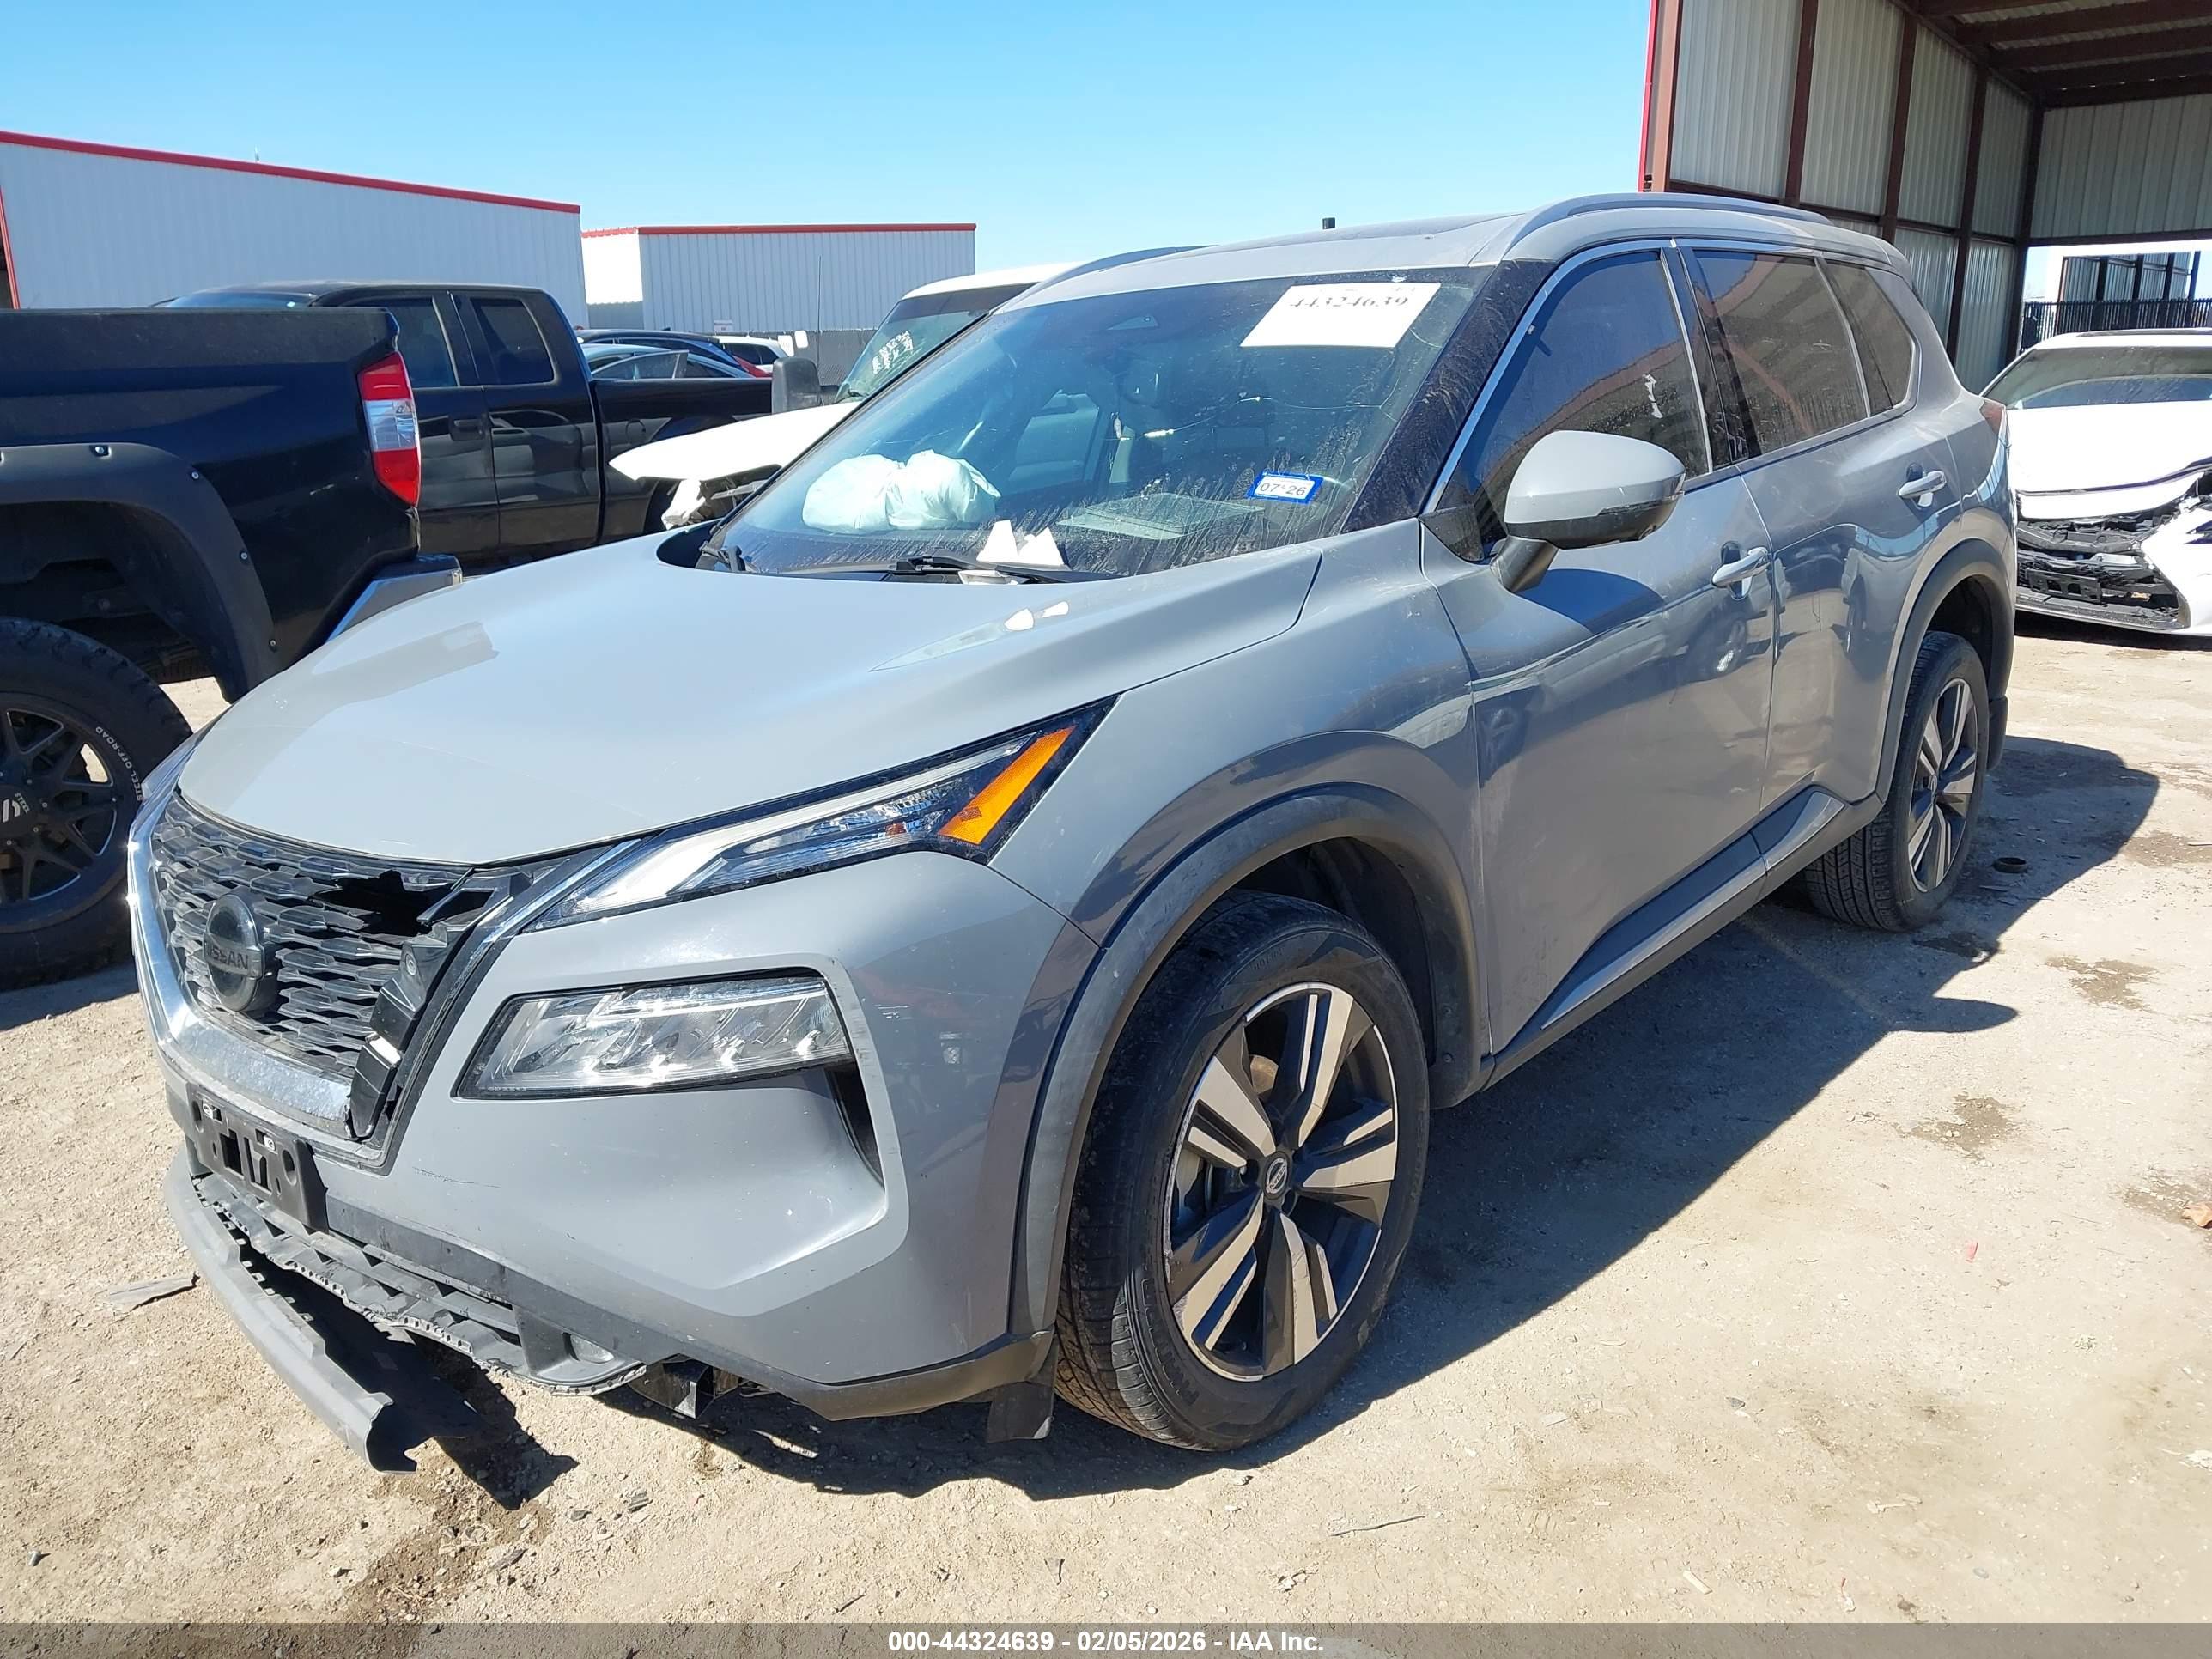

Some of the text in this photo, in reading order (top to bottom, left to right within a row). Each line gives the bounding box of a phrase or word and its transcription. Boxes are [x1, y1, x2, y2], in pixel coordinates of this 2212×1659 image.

[1260, 483, 1306, 495] 07 26
[95, 726, 143, 801] STEEL OFF-ROAD
